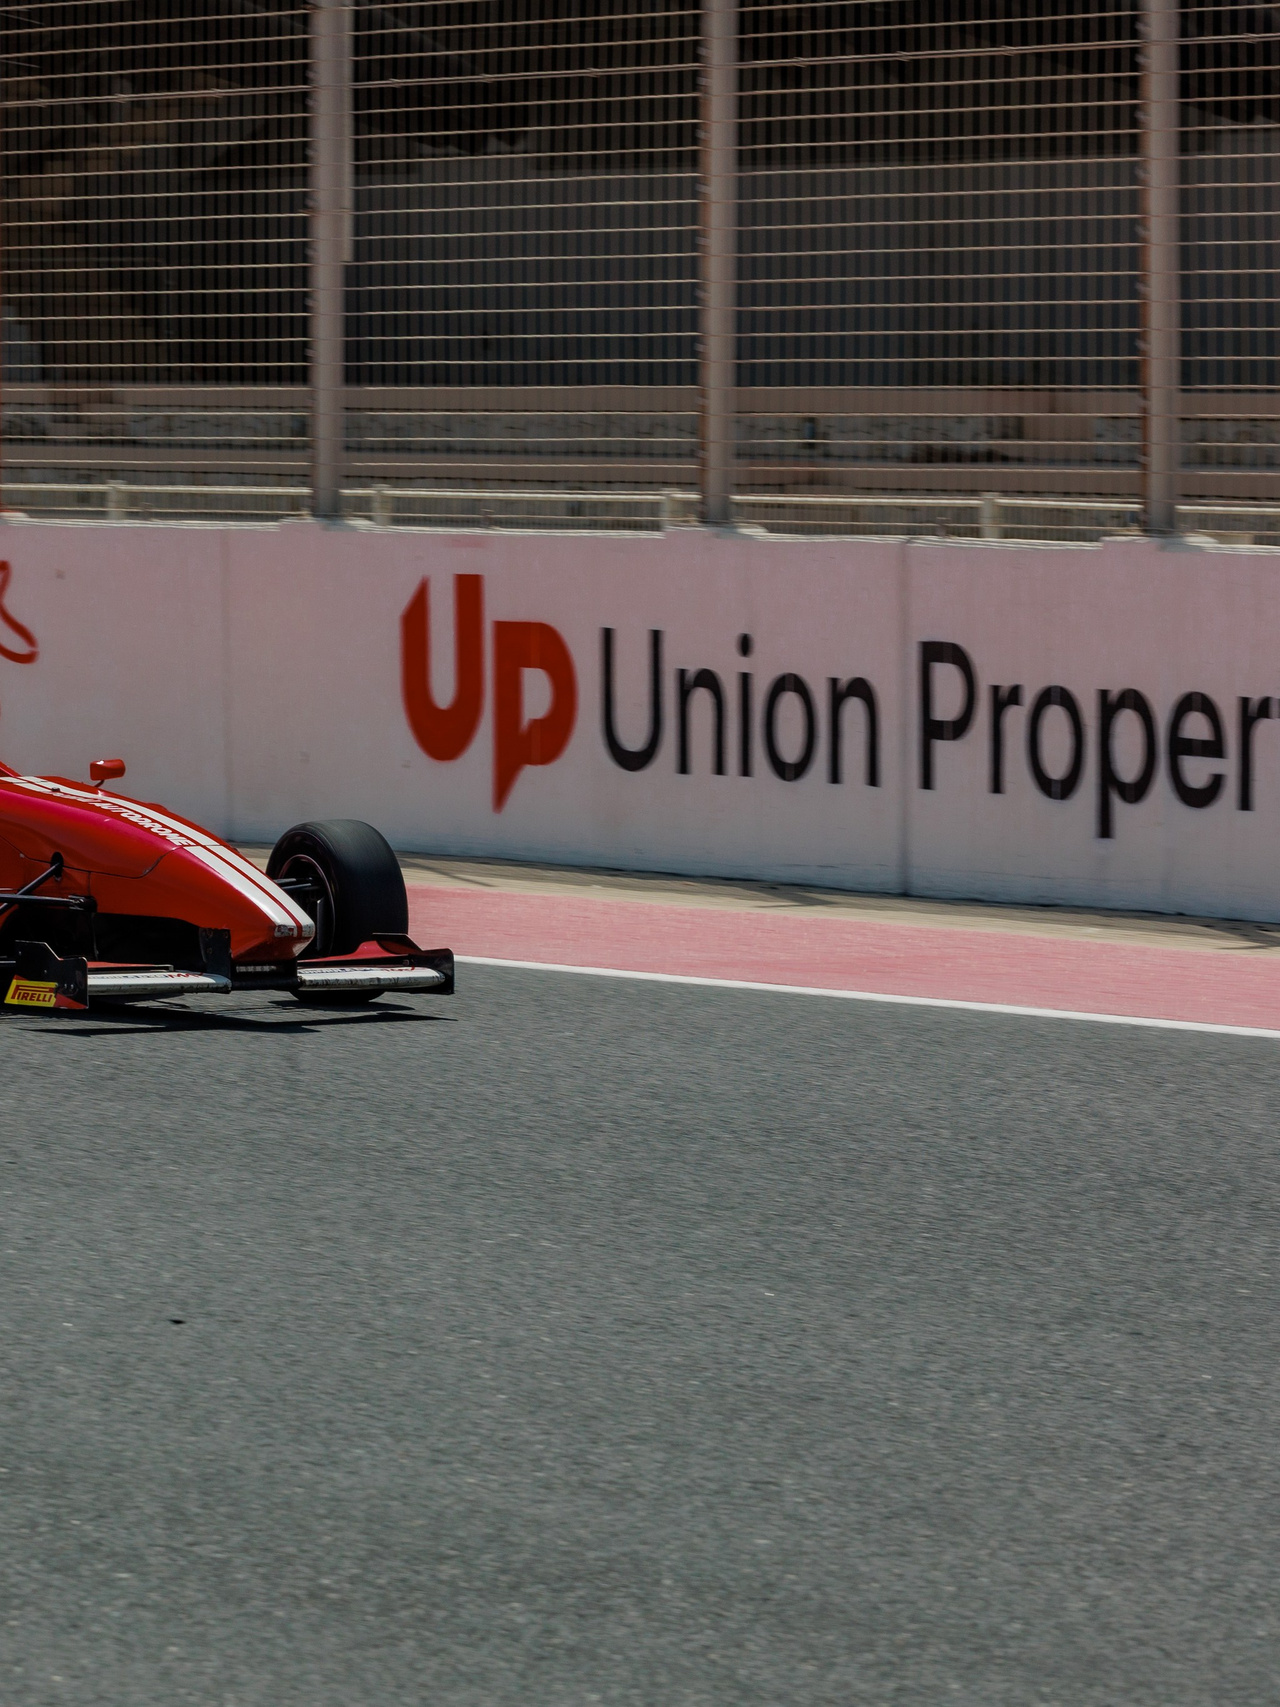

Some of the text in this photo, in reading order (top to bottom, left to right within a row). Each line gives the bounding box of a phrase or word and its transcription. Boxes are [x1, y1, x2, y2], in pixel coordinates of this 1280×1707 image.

[600, 626, 1280, 840] Union Proper
[88, 802, 196, 846] AUTODROME
[11, 984, 55, 1003] PIRELLI
